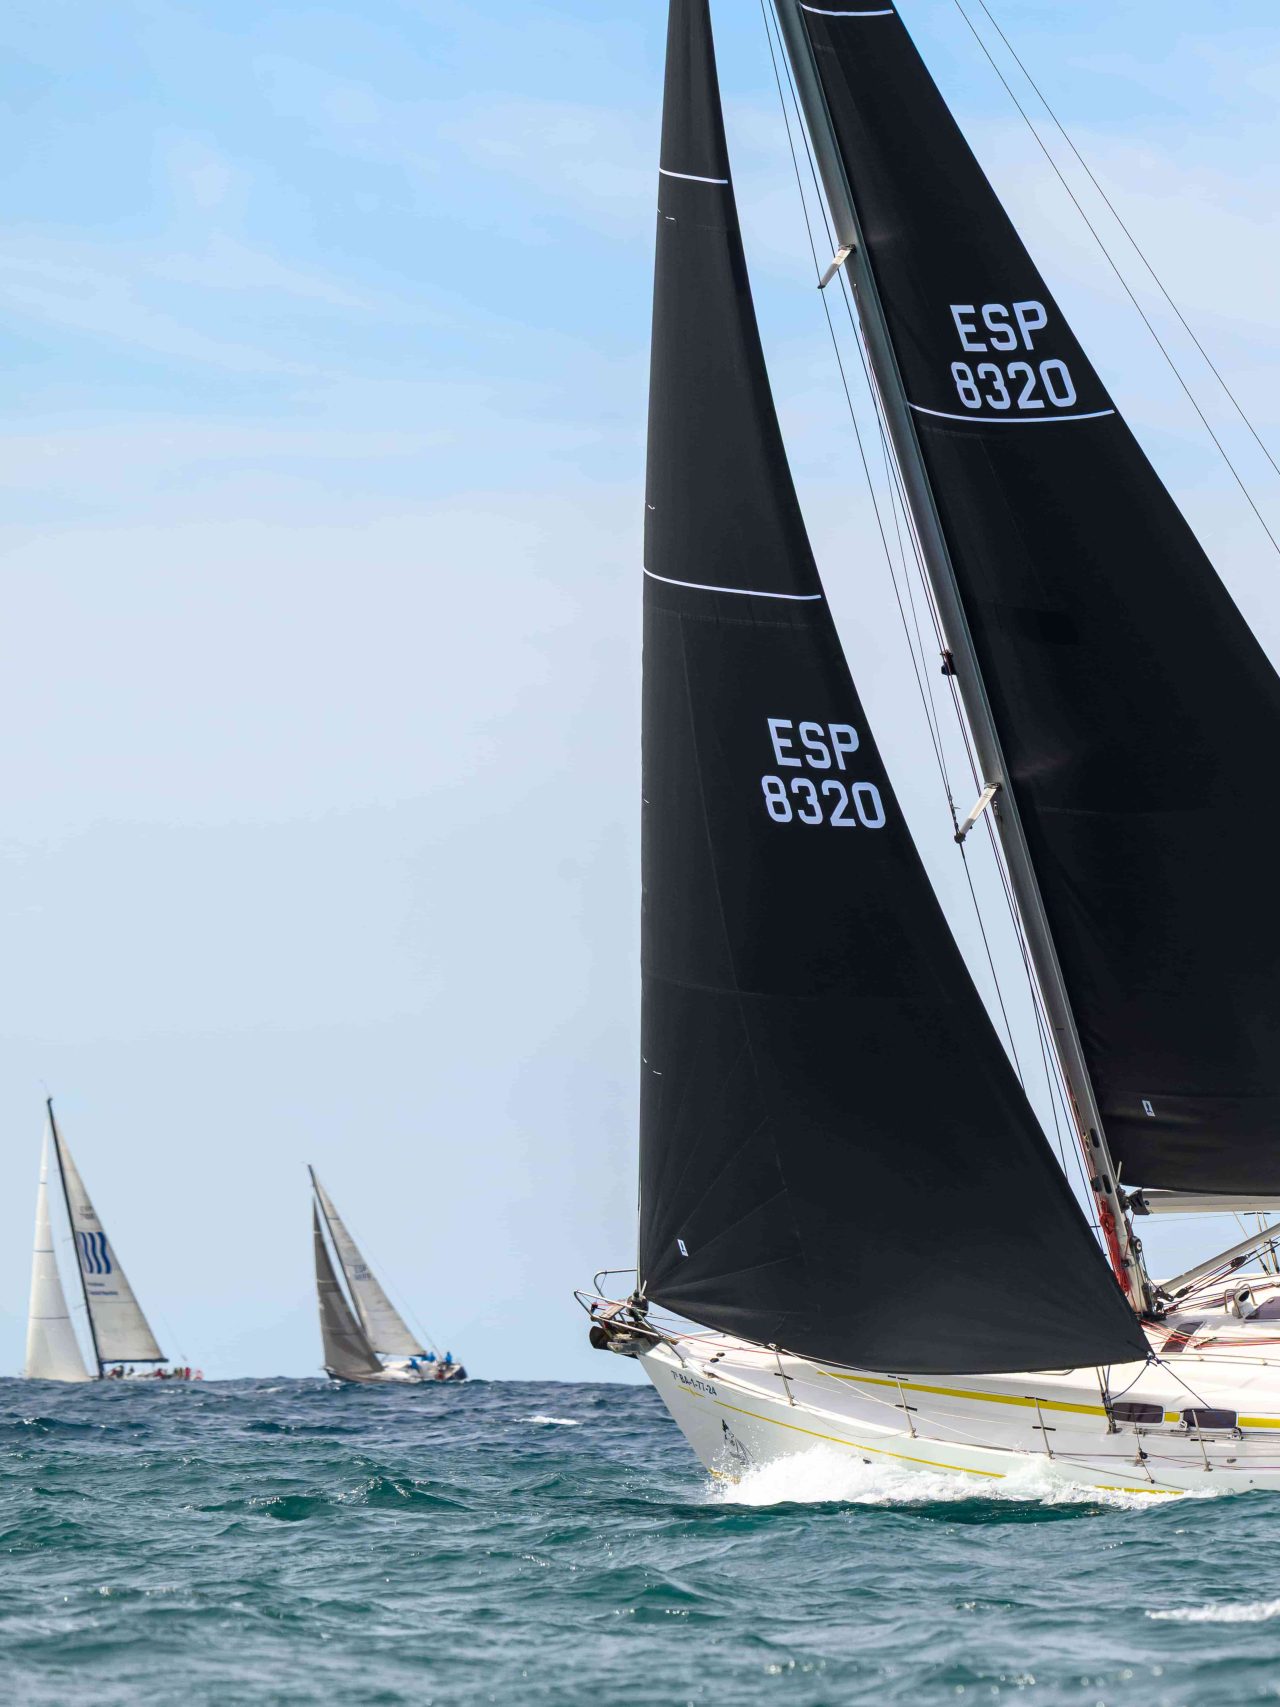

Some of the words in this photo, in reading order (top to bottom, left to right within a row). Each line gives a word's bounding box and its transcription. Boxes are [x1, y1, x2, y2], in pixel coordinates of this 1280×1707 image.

[950, 300, 1048, 352] ESP
[951, 358, 1077, 409] 8320
[767, 718, 859, 770] ESP
[761, 775, 886, 829] 8320
